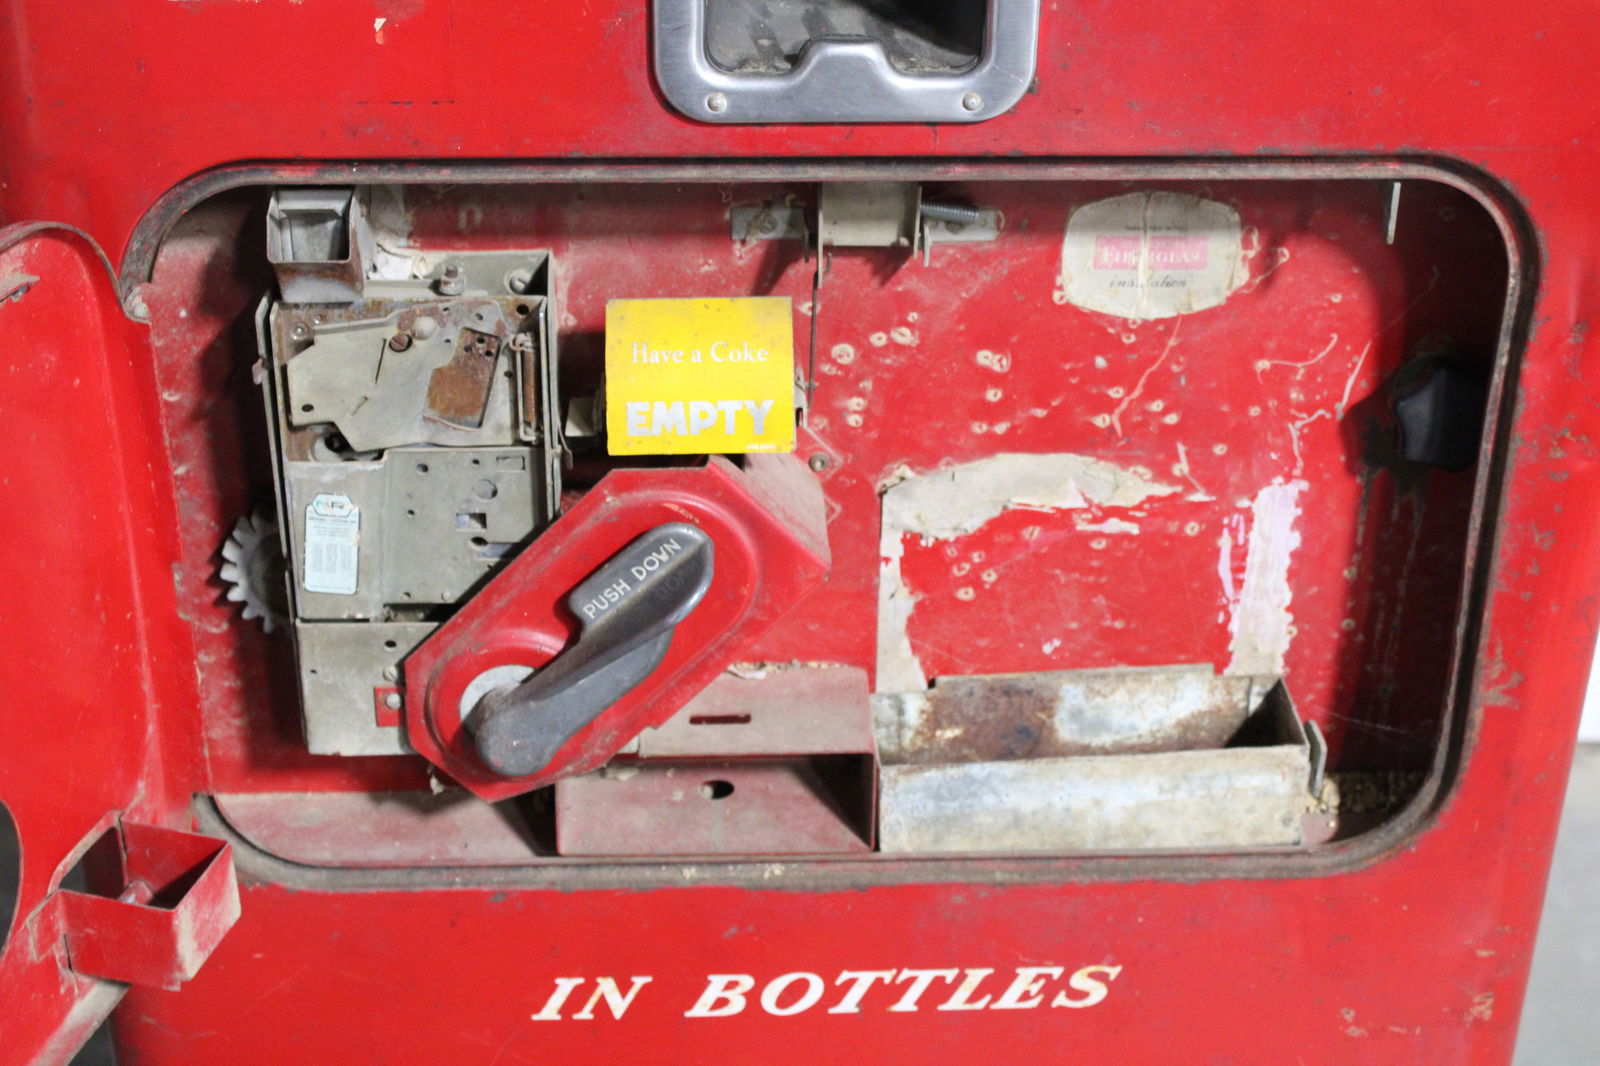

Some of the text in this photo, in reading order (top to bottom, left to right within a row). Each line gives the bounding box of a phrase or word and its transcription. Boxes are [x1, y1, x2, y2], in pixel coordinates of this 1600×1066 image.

[631, 340, 769, 363] Have a Coke
[626, 400, 775, 437] EMPTY
[582, 538, 682, 619] PUSH DOWN
[530, 964, 1123, 1021] IN BOTTLES
